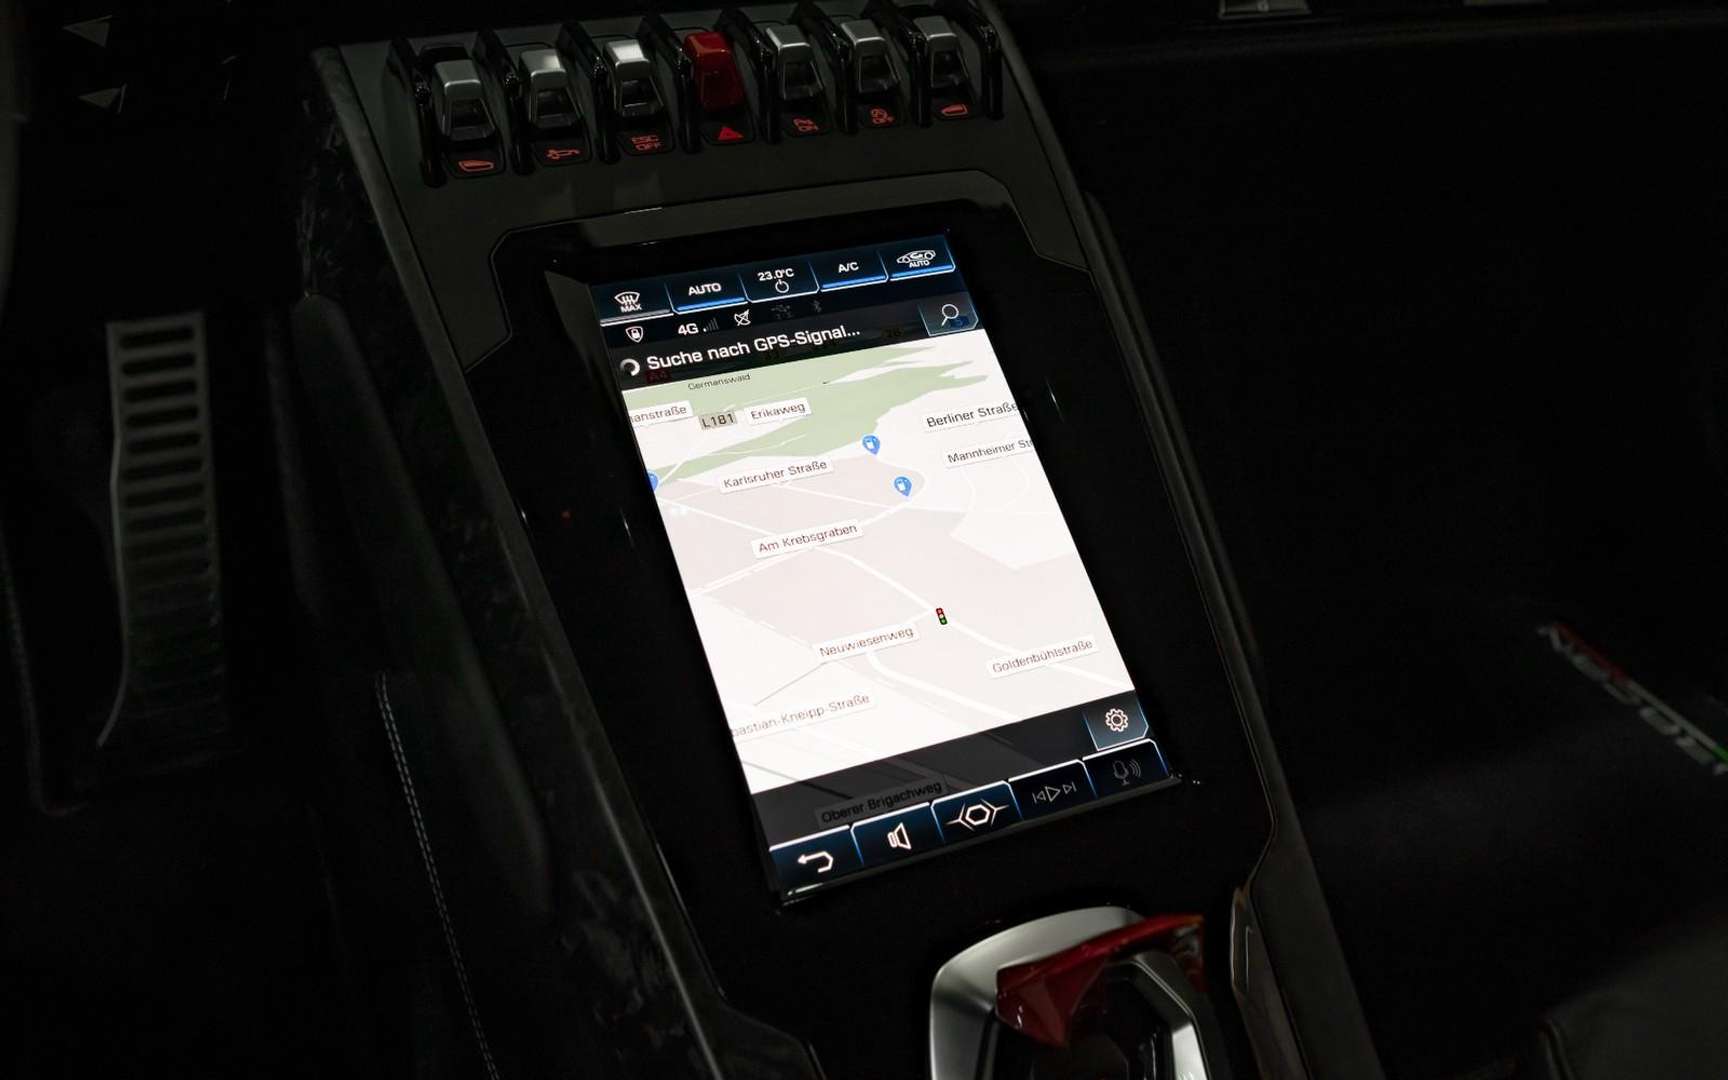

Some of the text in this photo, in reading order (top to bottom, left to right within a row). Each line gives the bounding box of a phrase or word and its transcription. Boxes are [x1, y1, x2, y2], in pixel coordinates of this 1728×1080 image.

[837, 261, 860, 274] A/C
[908, 259, 931, 269] AUTO
[688, 281, 722, 297] AUTO
[620, 302, 642, 313] MAX
[677, 322, 699, 337] 4G
[646, 350, 704, 371] Suche
[708, 341, 751, 361] nach
[754, 324, 861, 353] GPS-Signal...
[750, 402, 806, 420] Erikaweg
[926, 401, 1019, 428] Berliner Straße
[947, 442, 1016, 463] Mannheimer
[723, 460, 827, 489] Karlsruher Straße
[758, 523, 858, 553] Am Krebsgraben
[819, 627, 914, 657] Neuwiesenweg
[992, 639, 1093, 673] Goldenbühlstraße
[822, 781, 942, 823] Oberer Brigachweg
